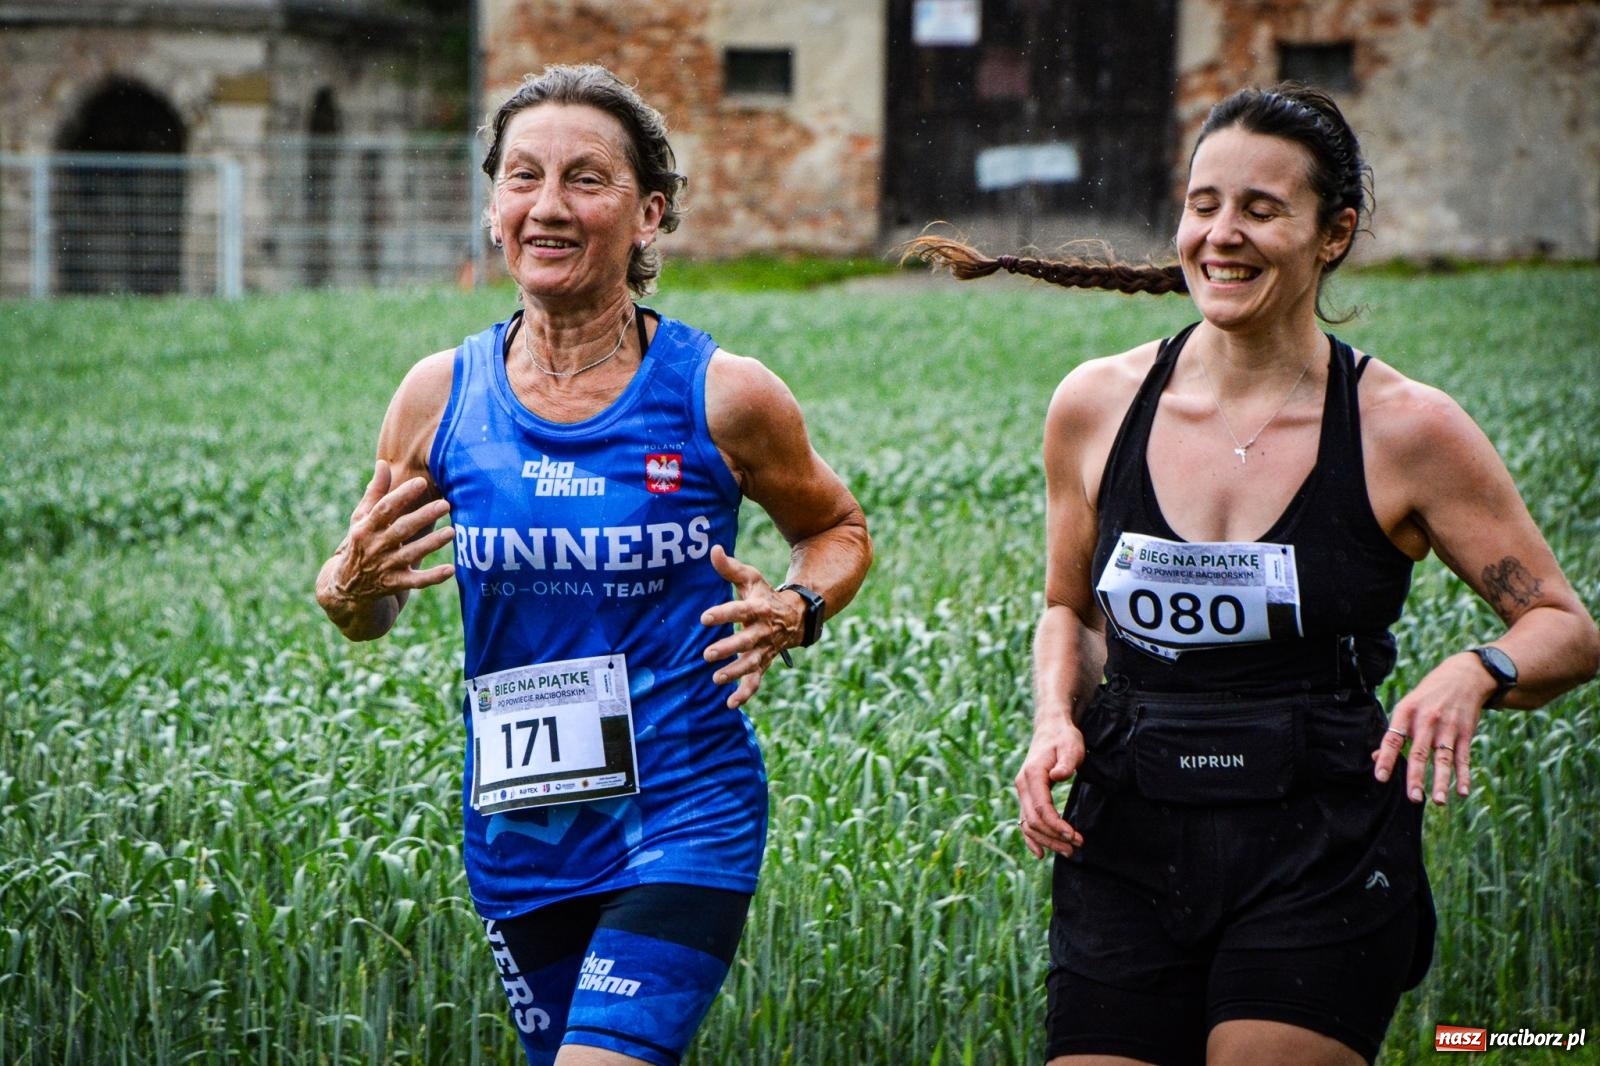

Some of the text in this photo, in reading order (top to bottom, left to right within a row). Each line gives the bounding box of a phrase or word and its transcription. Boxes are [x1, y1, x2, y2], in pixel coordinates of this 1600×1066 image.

[454, 515, 711, 571] RUNNERS
[1139, 548, 1259, 570] BIEG NA PIĄTKĘ
[1141, 566, 1254, 580] PO POWIECIE RACIBORSKIM
[603, 579, 664, 598] TEAM
[1129, 588, 1245, 636] 080
[494, 681, 516, 697] BIEG
[518, 678, 536, 692] NA
[538, 671, 590, 690] PIĄTKĘ
[498, 688, 586, 708] PO POWIECIE RACIBORSKIM
[501, 716, 561, 770] 171
[1180, 754, 1245, 769] KIPRUN
